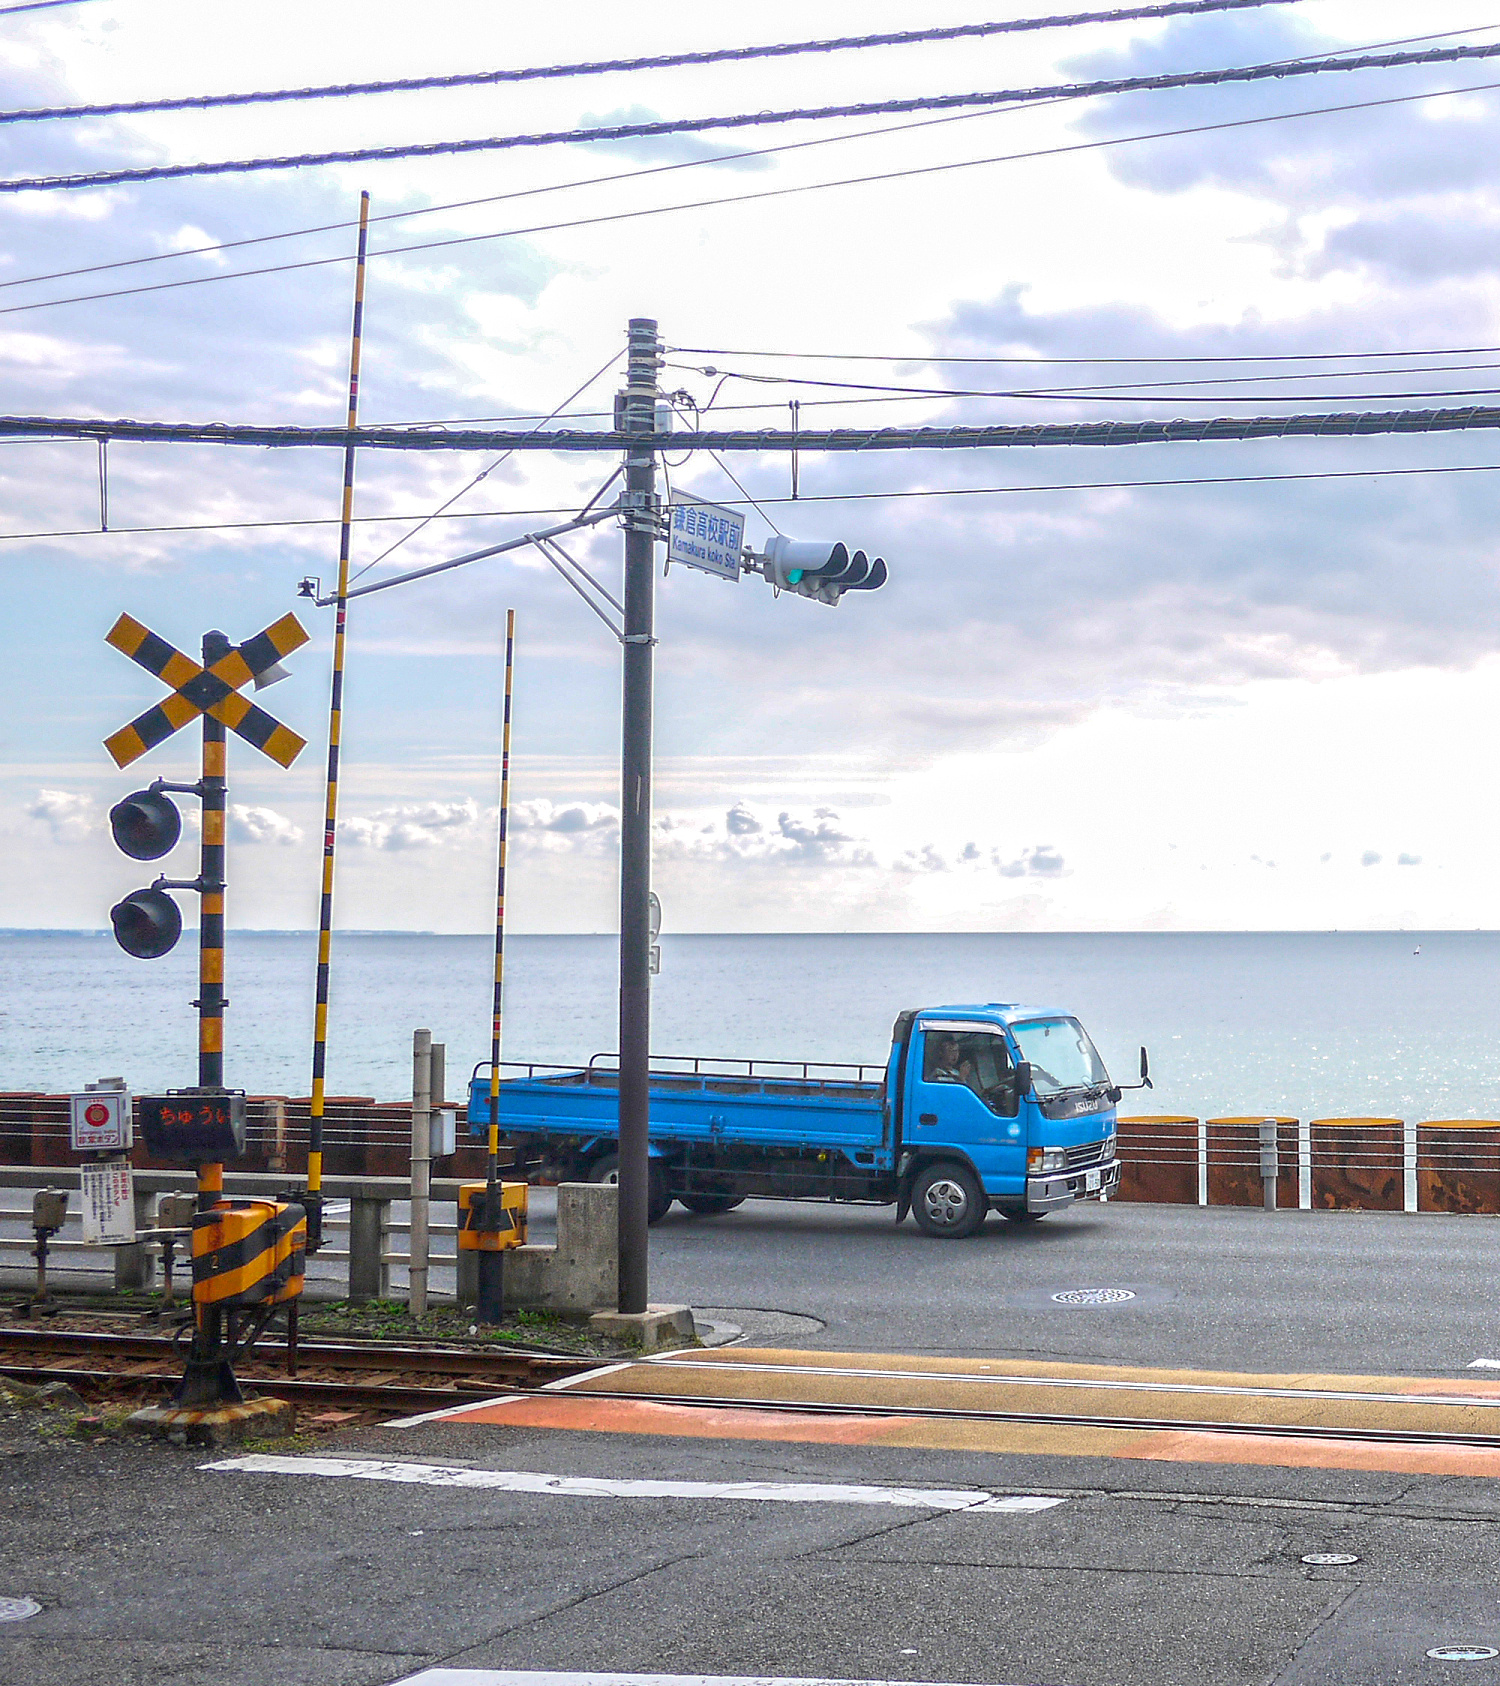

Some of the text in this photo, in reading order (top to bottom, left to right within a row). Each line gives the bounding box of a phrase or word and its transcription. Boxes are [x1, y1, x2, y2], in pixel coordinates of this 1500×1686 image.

[673, 503, 740, 551] 鎌倉高校駅前
[673, 534, 706, 559] Kamakura
[1075, 1100, 1099, 1113] ISUZU
[211, 1254, 219, 1269] 2
